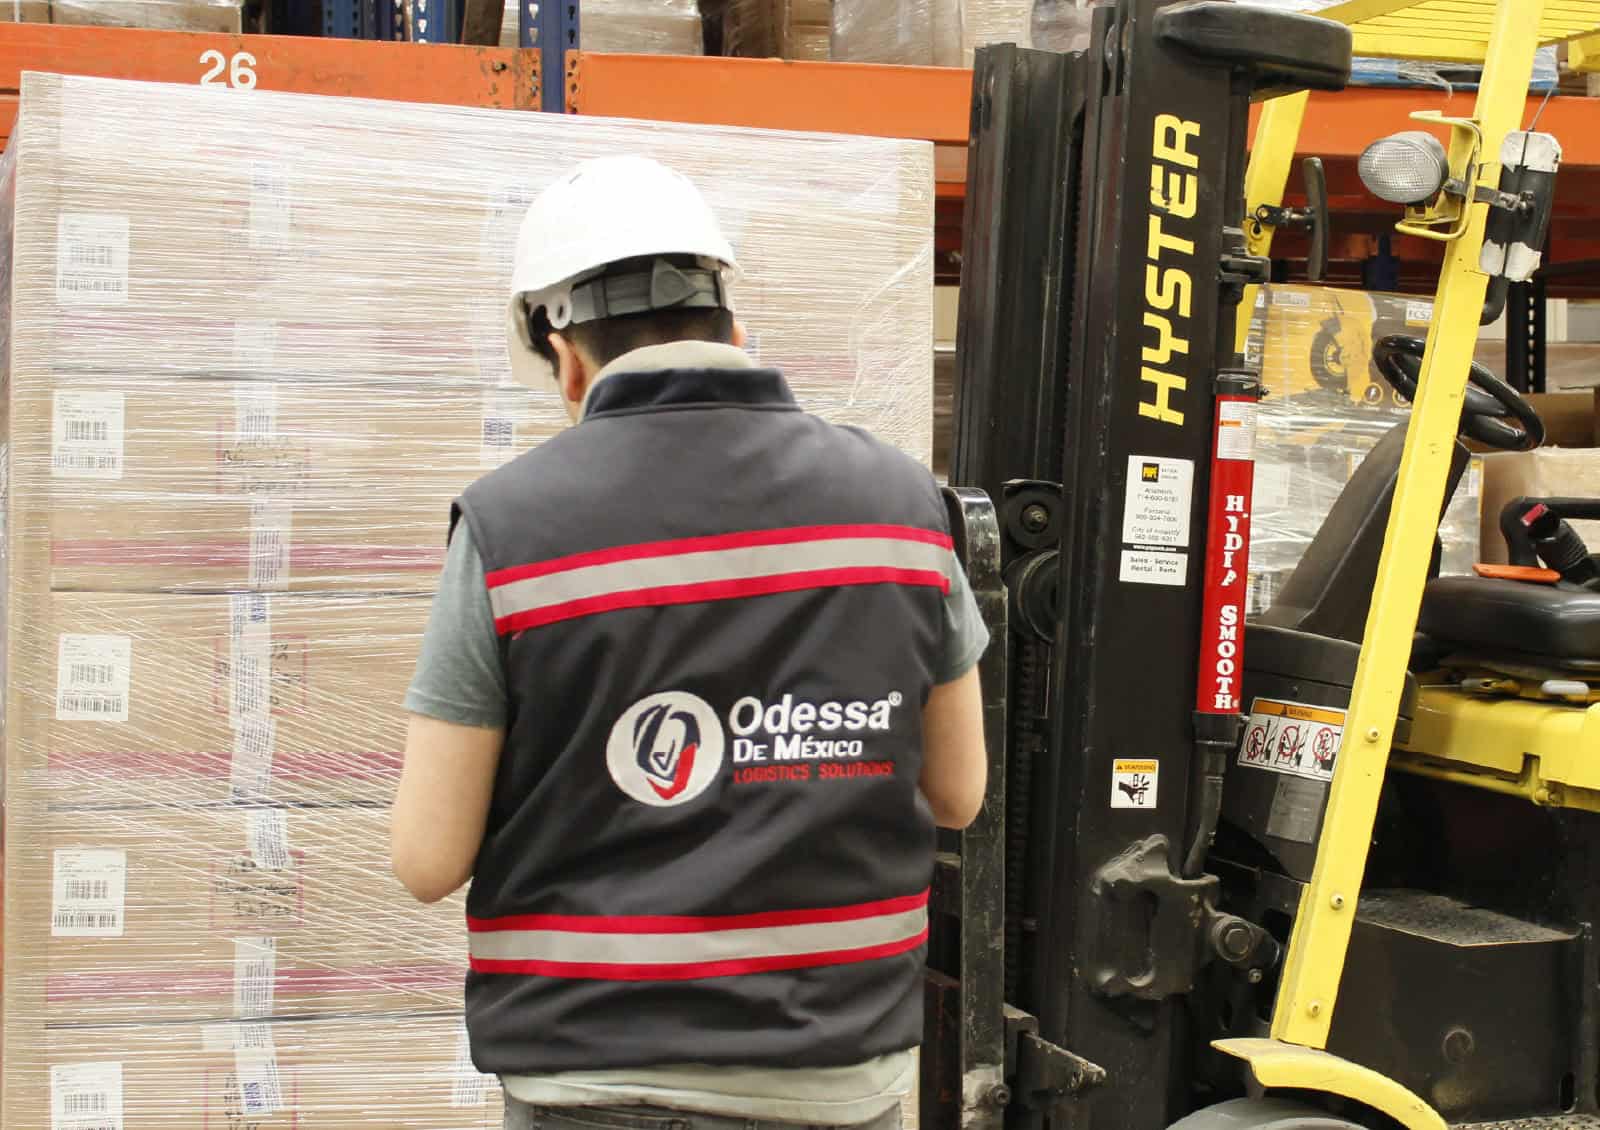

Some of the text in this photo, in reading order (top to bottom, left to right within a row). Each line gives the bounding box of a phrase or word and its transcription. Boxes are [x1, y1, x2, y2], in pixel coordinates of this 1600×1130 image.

[199, 49, 257, 90] 26
[1138, 113, 1200, 426] HYSTER
[1214, 605, 1238, 710] SMOOTH
[732, 760, 896, 785] LOGISTICS SOLUTIONS
